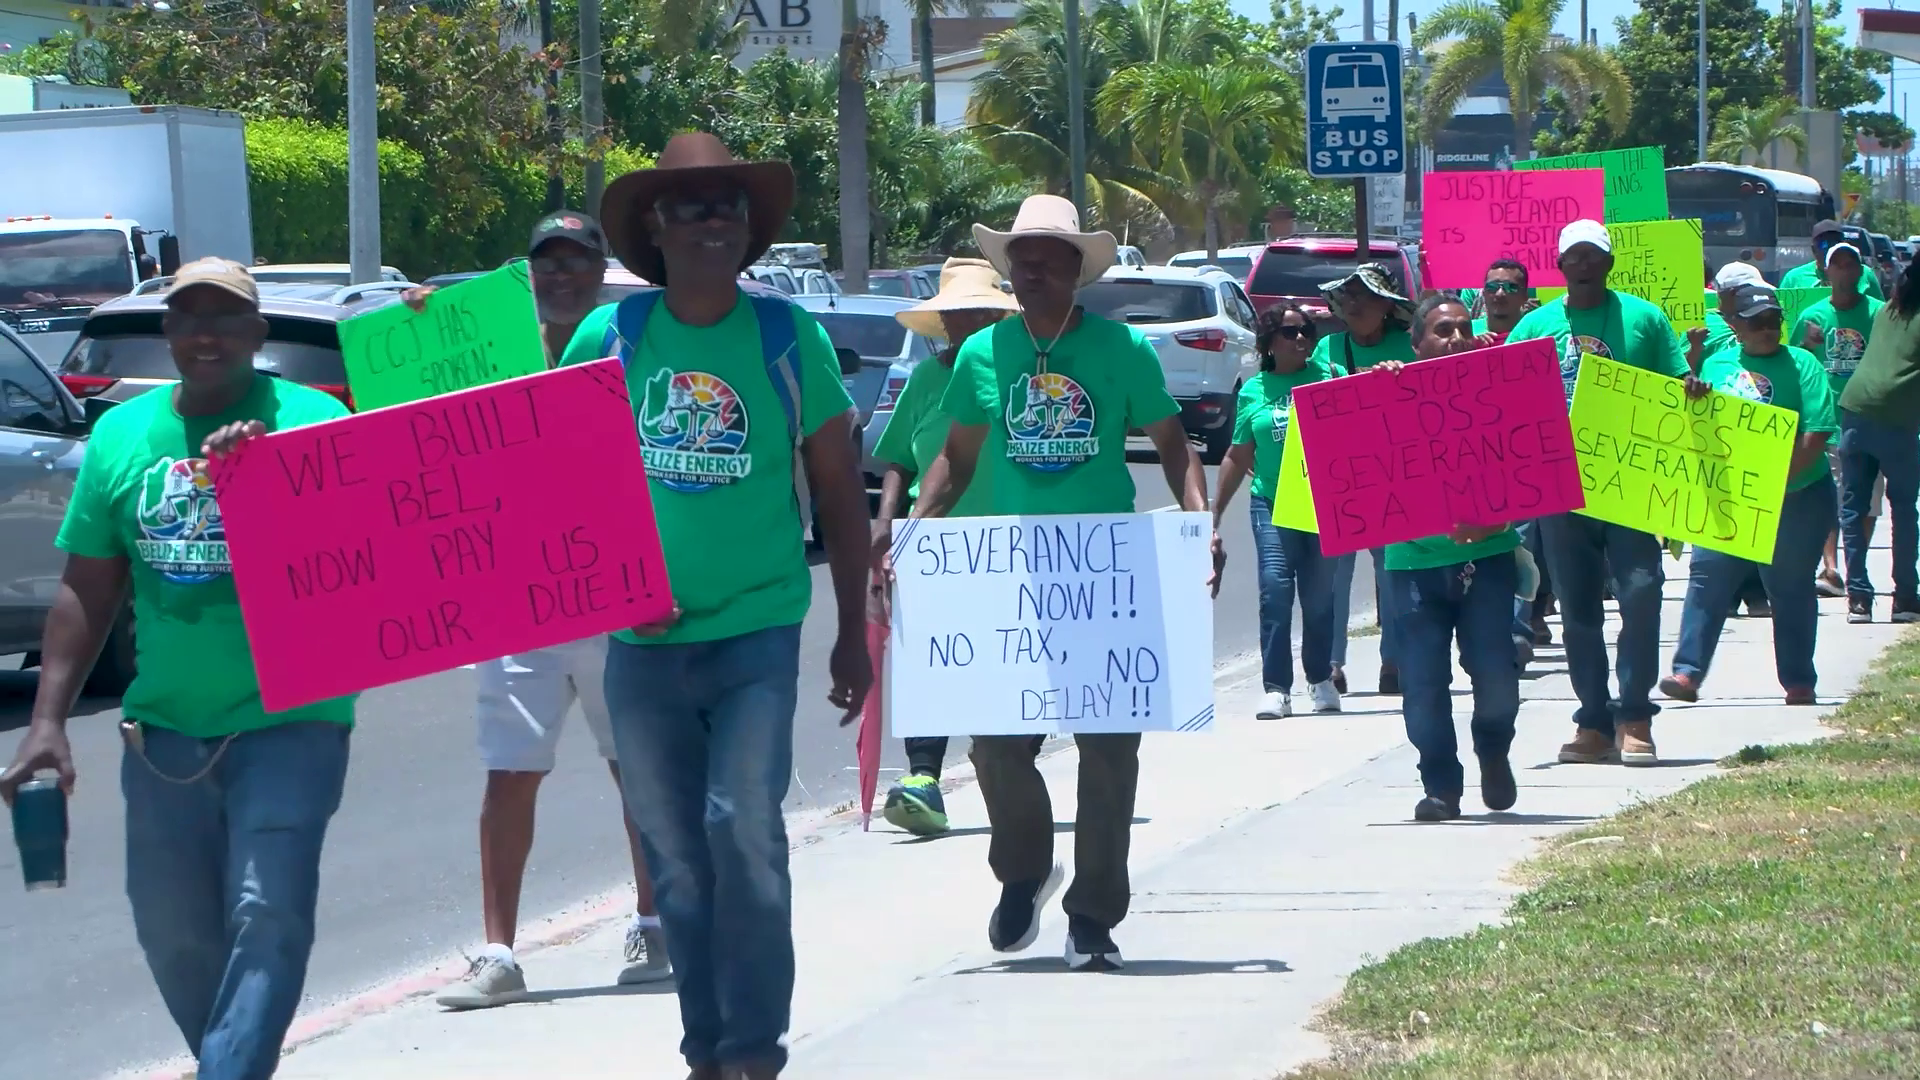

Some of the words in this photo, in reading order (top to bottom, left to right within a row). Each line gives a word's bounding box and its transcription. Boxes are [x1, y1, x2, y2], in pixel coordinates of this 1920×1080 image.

[1315, 149, 1399, 168] STOP
[1325, 129, 1389, 147] BUS
[1436, 153, 1490, 163] RIDGELINE
[1616, 148, 1649, 171] THE
[1439, 171, 1534, 201] JUSTICE
[1489, 195, 1581, 224] DELAYED
[1439, 226, 1466, 244] IS
[1502, 225, 1560, 246] JUSTI
[1500, 246, 1558, 271] DENIE
[1620, 249, 1654, 266] THE
[364, 314, 423, 375] CCJ
[435, 297, 480, 350] HAS
[1394, 360, 1469, 403] STOP
[1486, 347, 1554, 385] PLAY
[1381, 386, 1504, 446] LOSS
[1630, 405, 1734, 459] LOSS
[1659, 380, 1727, 420] STOP
[1737, 402, 1796, 441] PLAY
[276, 431, 369, 497] WE
[410, 385, 544, 468] BUILT
[643, 450, 683, 470] ELIZE
[685, 454, 750, 475] ENERGY
[1008, 442, 1045, 455] BELIZE
[1048, 440, 1098, 455] ENERGY
[1327, 418, 1562, 495] SEVERANCE
[1575, 427, 1760, 502] SEVERANCE
[387, 468, 502, 528] BEL,
[680, 474, 697, 482] FOR
[699, 475, 731, 484] JUSTICE
[1331, 497, 1367, 539] IS
[1382, 491, 1410, 530] A
[1441, 456, 1572, 521] MUST
[1647, 483, 1774, 549] MUST
[185, 543, 229, 561] ENER
[287, 537, 378, 600] NOW
[430, 521, 497, 580] PAY
[541, 525, 600, 576] US
[917, 521, 1132, 576] SEVERANCE
[378, 601, 474, 661] OUR
[929, 632, 975, 668] NO
[995, 627, 1068, 664] TAX,
[1106, 646, 1160, 684] NO
